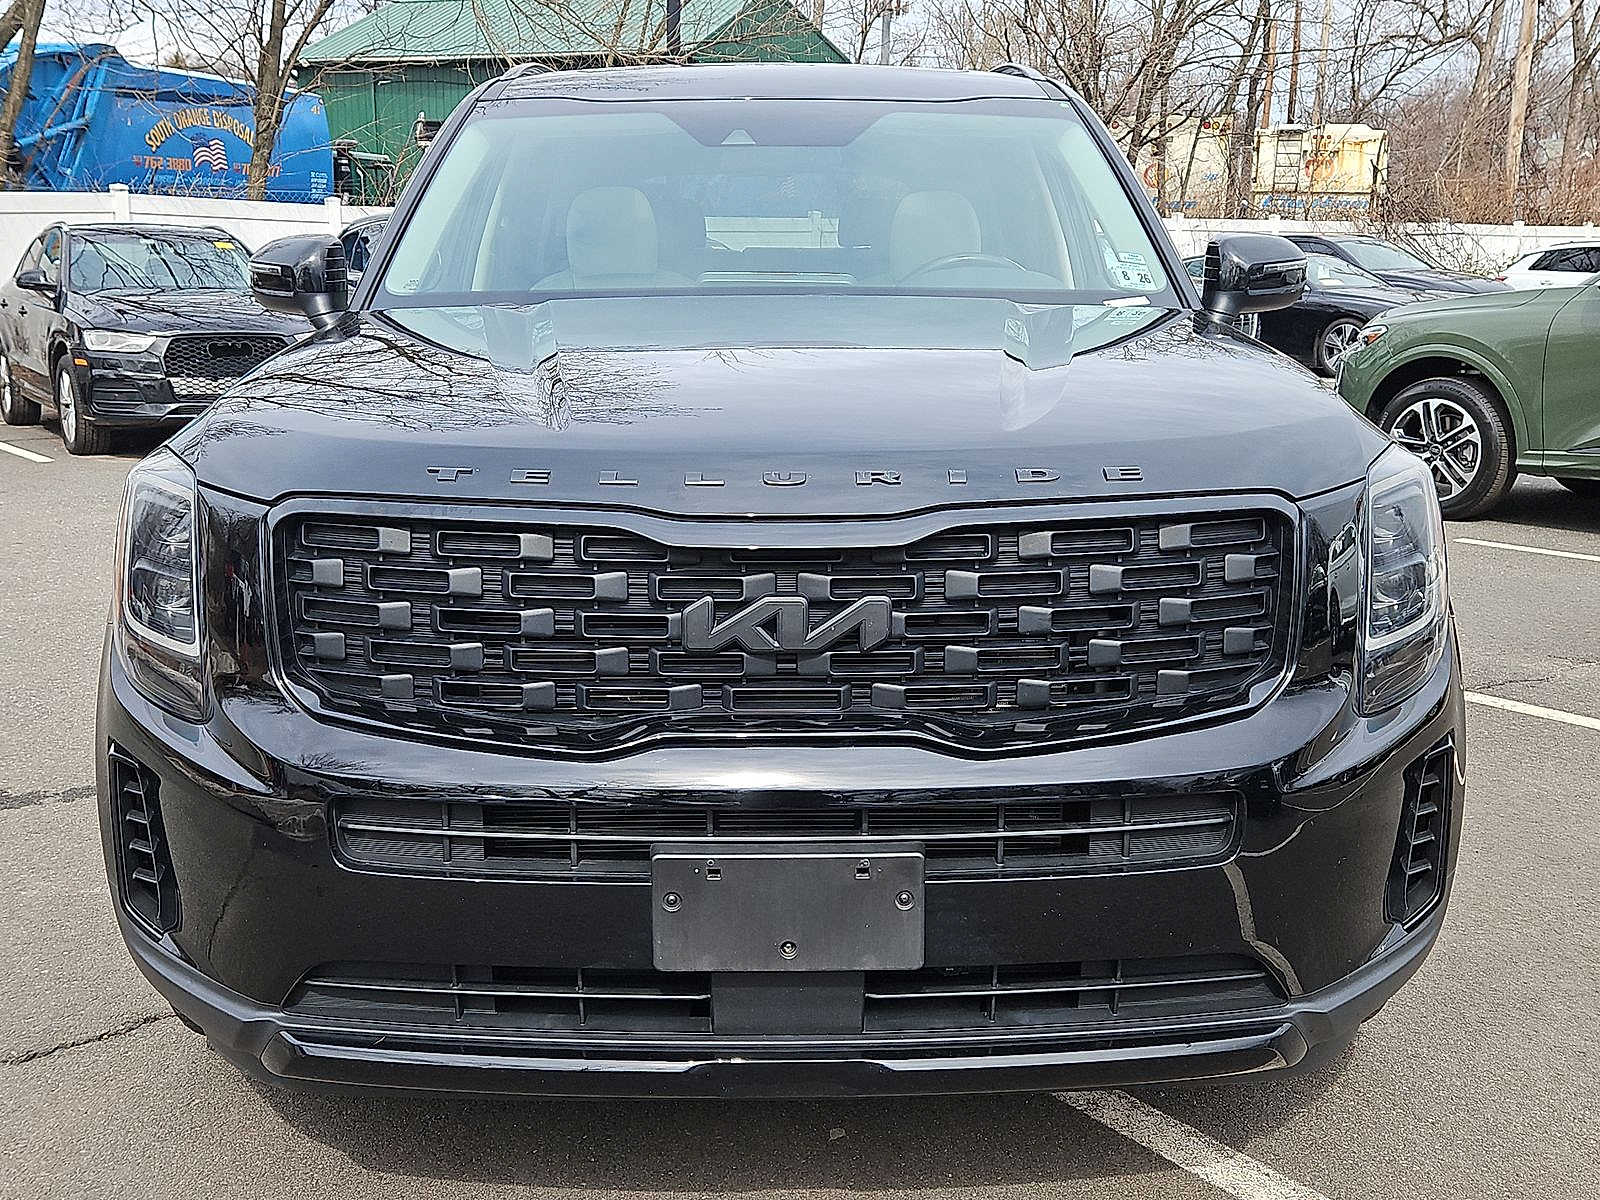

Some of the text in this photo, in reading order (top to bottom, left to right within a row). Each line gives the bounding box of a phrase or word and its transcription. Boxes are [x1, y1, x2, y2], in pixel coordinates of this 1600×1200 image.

[145, 108, 255, 152] SOUTH ORANGE DISPOSAL
[143, 155, 164, 169] 762
[1121, 270, 1151, 284] 8 26
[426, 465, 1144, 488] TELLURIDE
[681, 595, 892, 651] KIA
